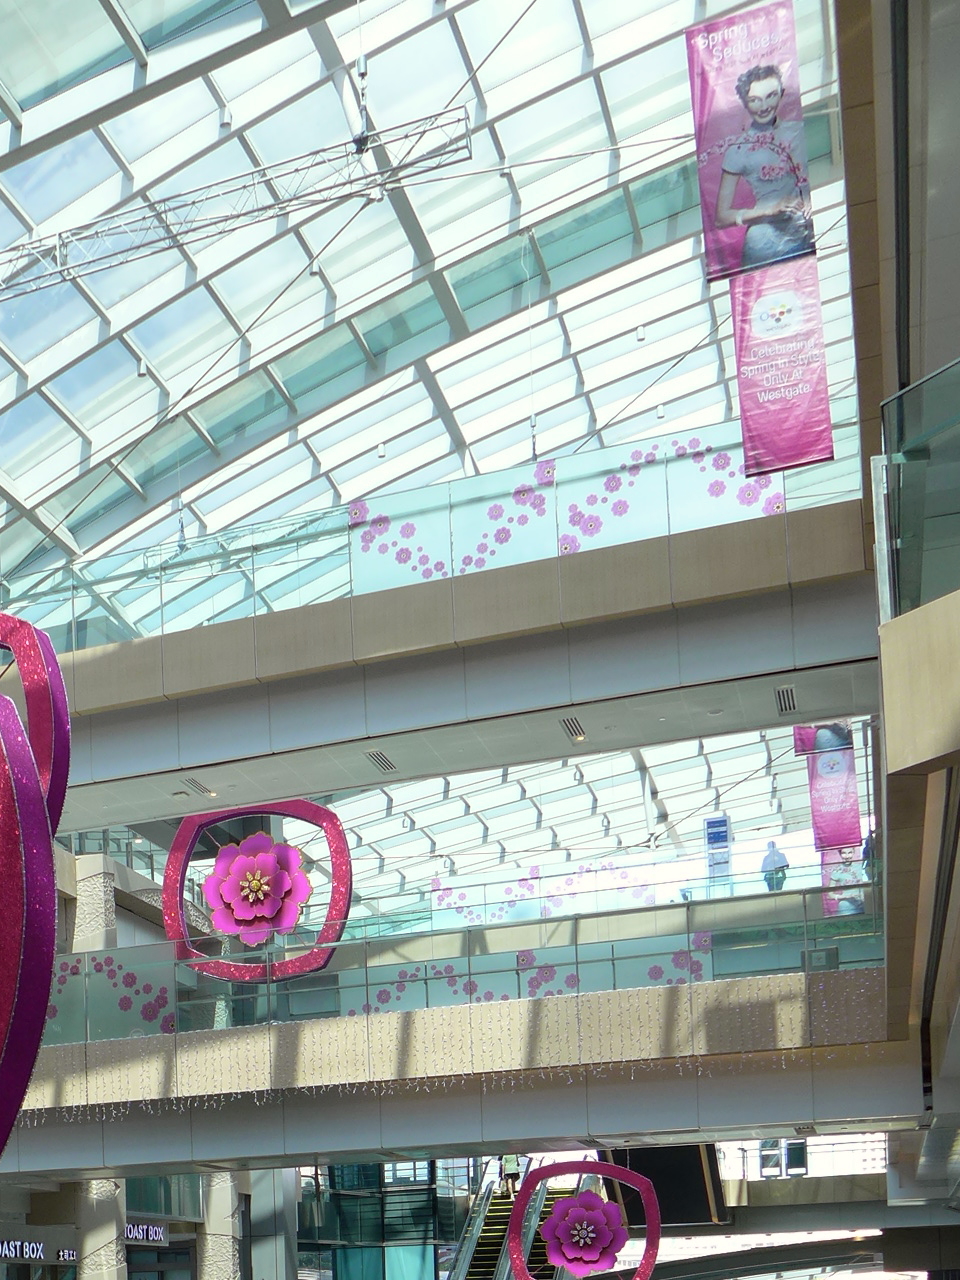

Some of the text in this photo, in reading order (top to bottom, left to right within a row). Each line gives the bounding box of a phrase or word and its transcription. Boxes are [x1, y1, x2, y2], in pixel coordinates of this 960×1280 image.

[698, 23, 748, 49] Spring
[751, 339, 815, 360] Celebrating
[740, 361, 775, 378] Spring
[763, 368, 803, 387] Only At
[124, 1223, 164, 1241] TOAST BOX
[23, 1242, 44, 1259] BOX
